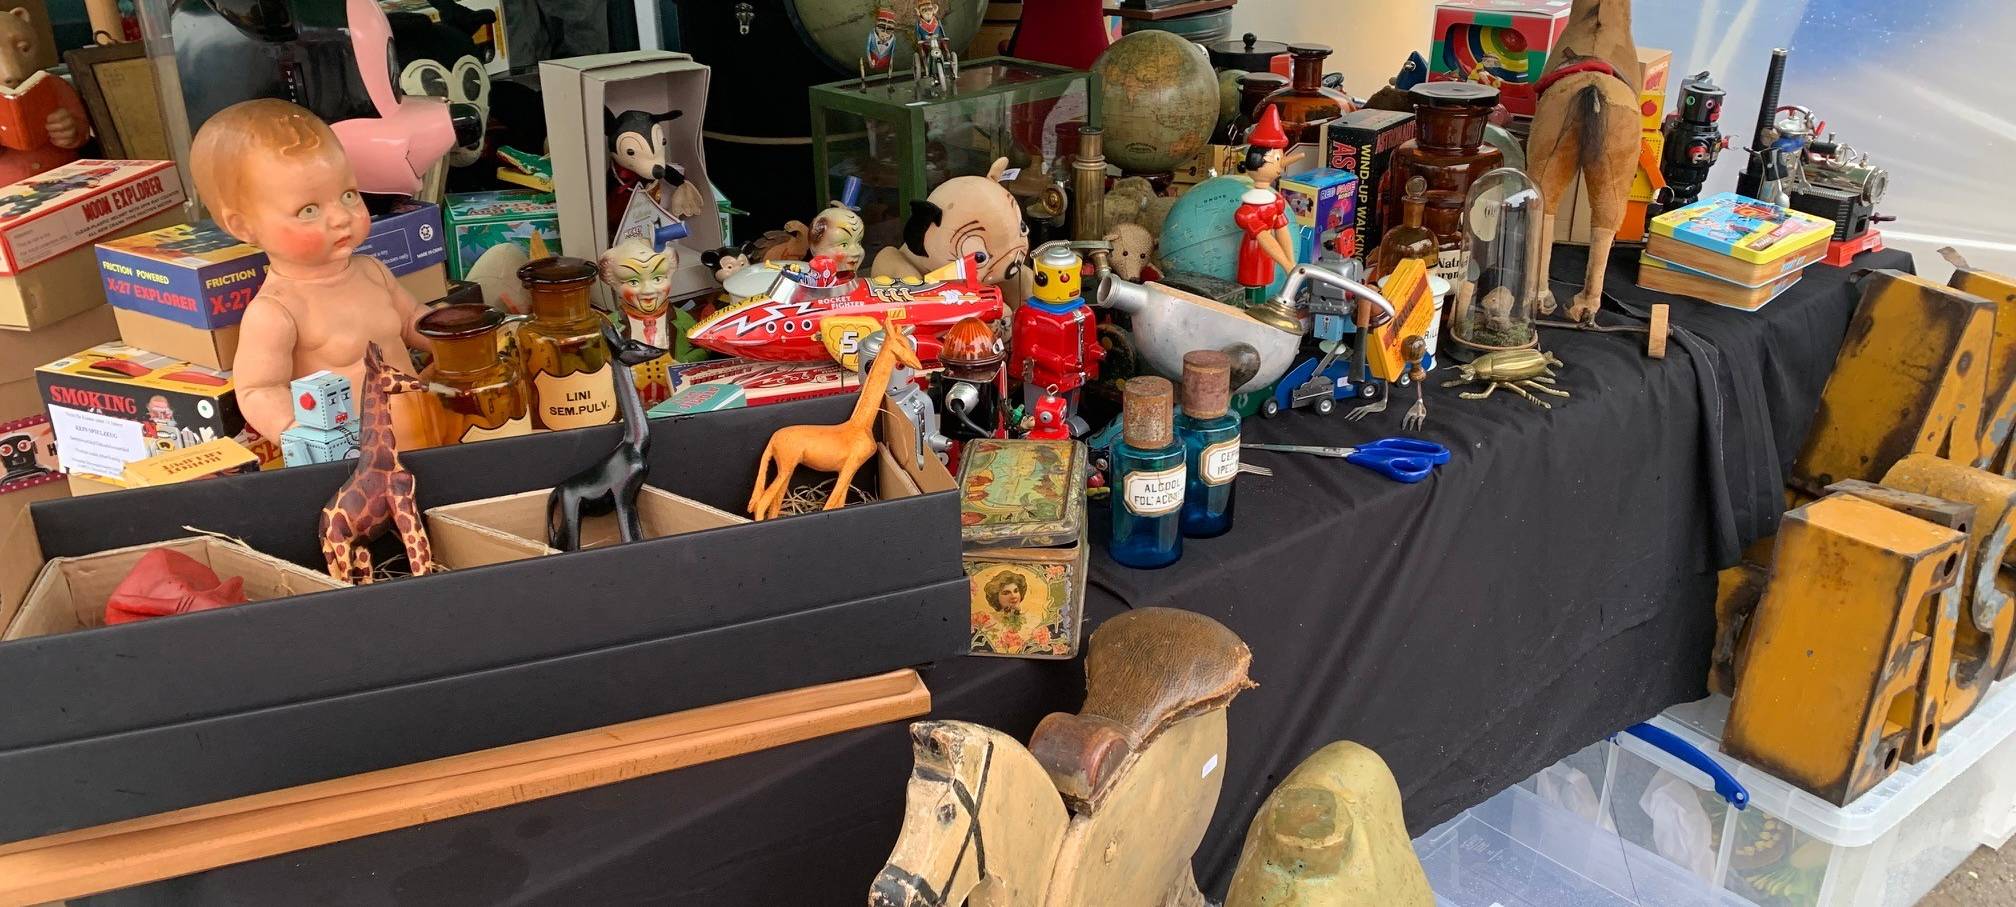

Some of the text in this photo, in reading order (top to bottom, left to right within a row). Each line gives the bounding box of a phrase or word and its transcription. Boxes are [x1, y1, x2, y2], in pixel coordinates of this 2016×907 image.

[1358, 144, 1373, 204] WIND-UP
[82, 176, 164, 222] MOON EXPLORER
[102, 261, 170, 285] FRICTION POWERED
[205, 268, 257, 289] FRICTION
[133, 285, 198, 312] EXPLORER
[210, 288, 254, 316] X-27
[817, 295, 852, 304] ROCKET
[831, 300, 865, 310] FIGHTER
[842, 331, 860, 356] 5
[49, 385, 137, 414] SMOKING
[566, 390, 591, 402] LINI
